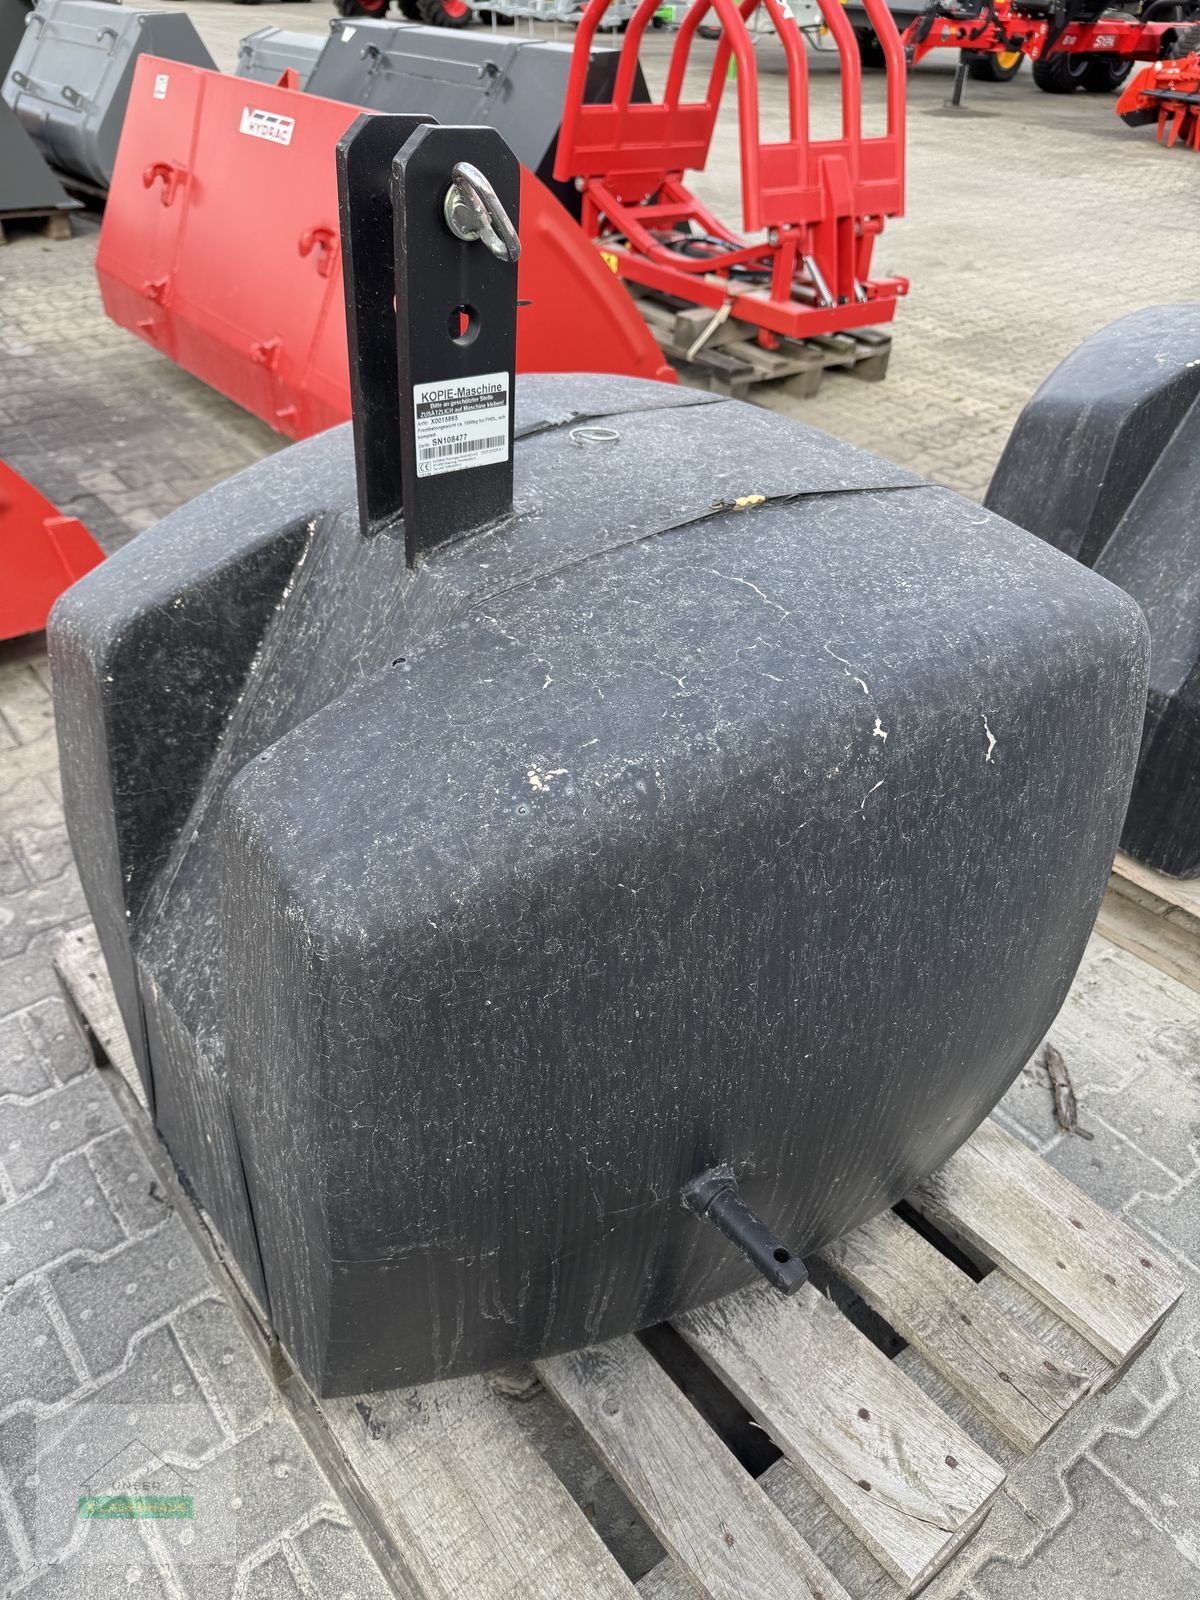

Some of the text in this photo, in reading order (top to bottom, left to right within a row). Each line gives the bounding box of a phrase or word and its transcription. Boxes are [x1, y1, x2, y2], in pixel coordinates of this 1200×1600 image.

[247, 121, 290, 142] HYDRAC
[421, 383, 502, 403] KOPIE-Maschine
[420, 407, 454, 418] ZUSÄTZLICH
[463, 402, 486, 411] Maschine
[430, 401, 442, 409] Bitte
[432, 433, 468, 447] SN108477
